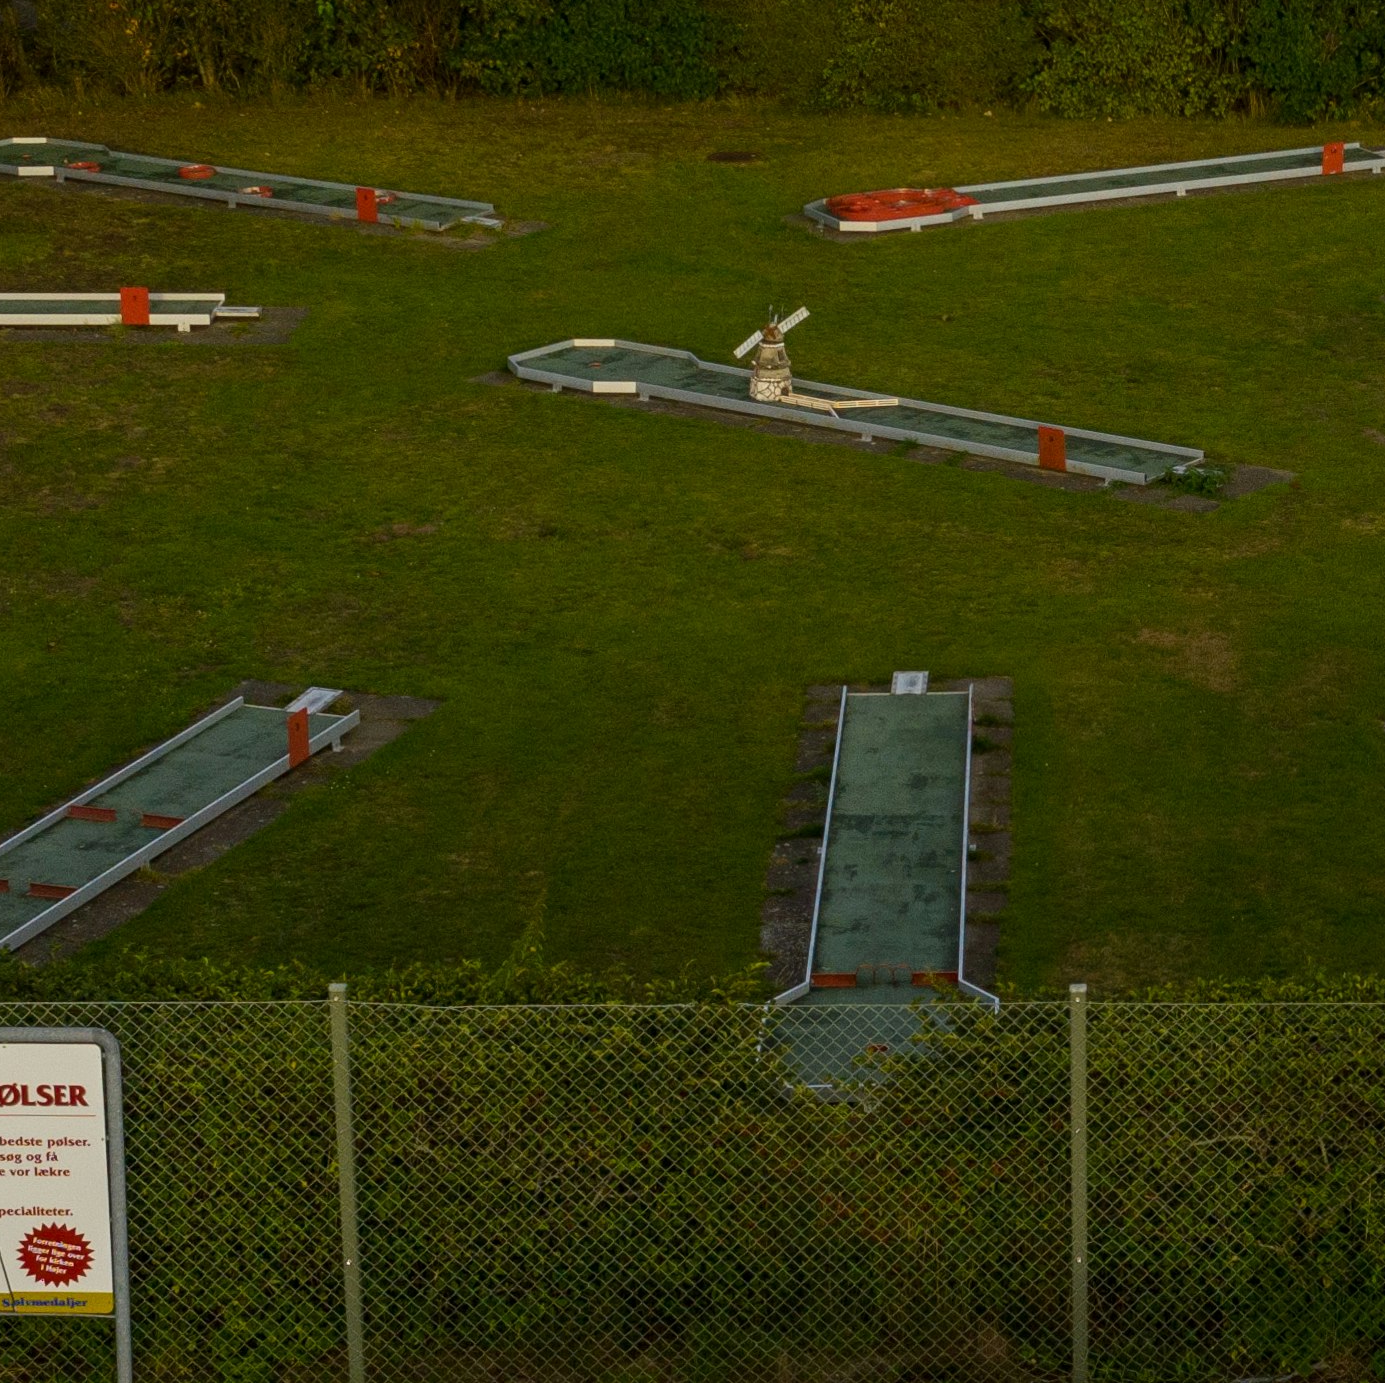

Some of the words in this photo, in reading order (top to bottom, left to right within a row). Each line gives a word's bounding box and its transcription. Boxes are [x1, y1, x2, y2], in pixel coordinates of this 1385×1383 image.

[0, 1136, 43, 1147] bedste
[47, 1136, 91, 1150] pølser.
[26, 1154, 43, 1164] og
[45, 1151, 59, 1162] få
[10, 1168, 31, 1177] vor
[34, 1166, 71, 1177] lækre
[67, 1252, 85, 1260] over
